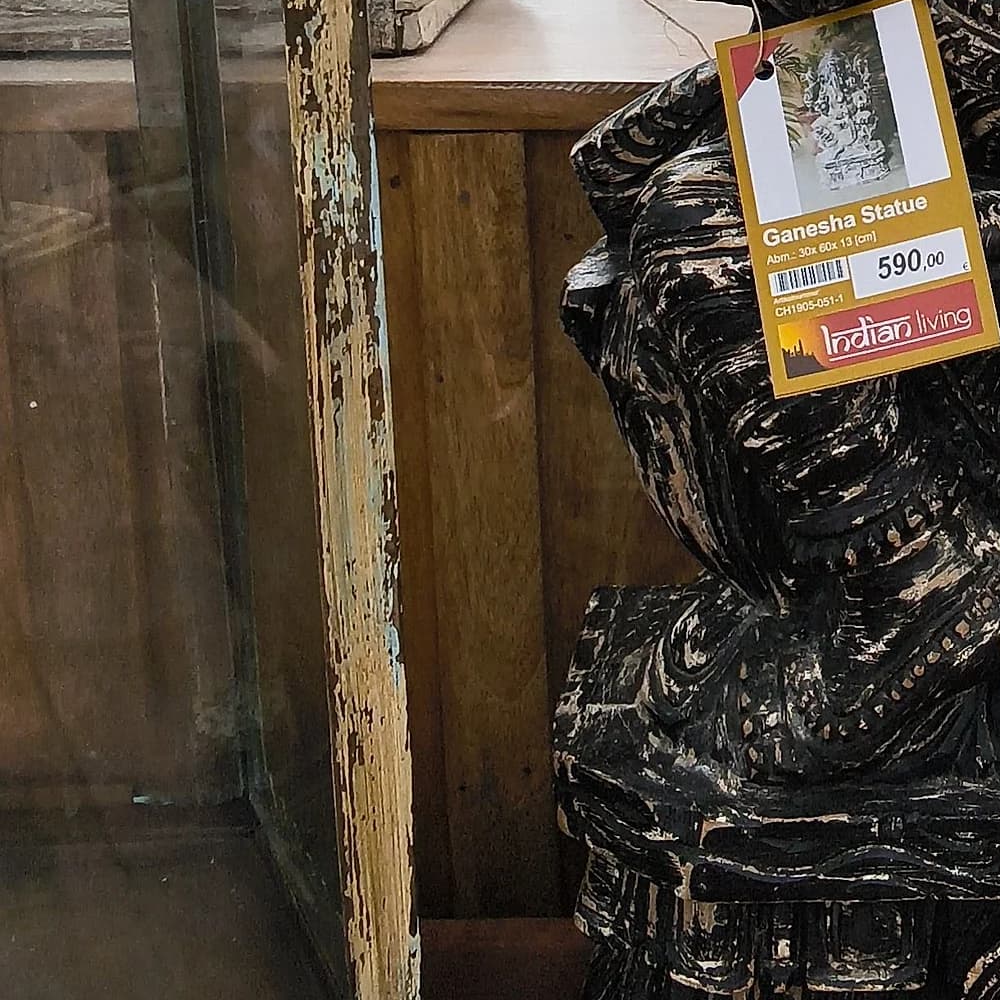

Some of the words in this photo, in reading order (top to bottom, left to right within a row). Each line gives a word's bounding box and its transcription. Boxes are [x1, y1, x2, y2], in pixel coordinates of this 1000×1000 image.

[762, 214, 857, 247] Ganesha
[861, 196, 928, 223] Statue
[798, 246, 817, 258] 30x
[877, 248, 945, 280] 590,00
[775, 293, 844, 318] CH1905-051-1
[820, 315, 912, 356] Indian
[916, 305, 972, 335] living
